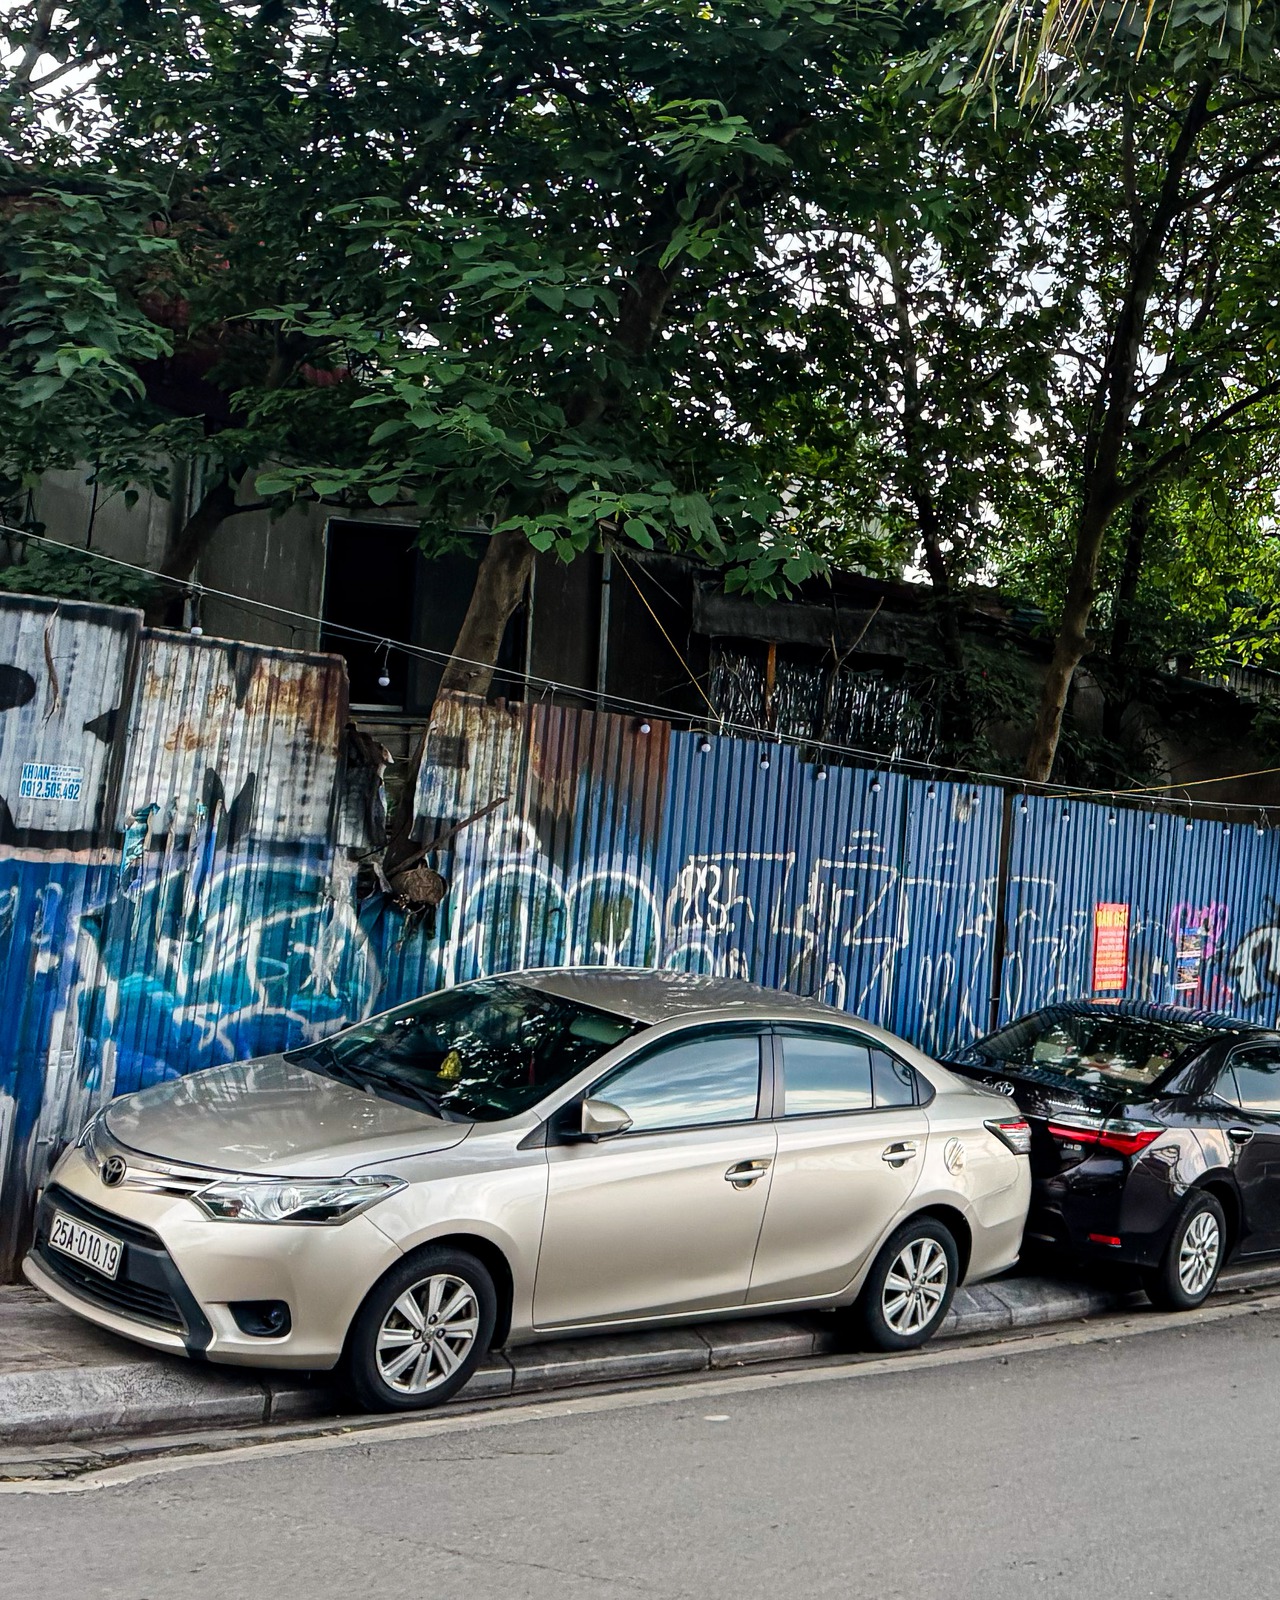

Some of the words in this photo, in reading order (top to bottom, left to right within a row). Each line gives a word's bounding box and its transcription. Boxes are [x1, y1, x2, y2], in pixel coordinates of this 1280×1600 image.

[22, 764, 51, 780] KHOAN
[20, 780, 80, 800] 0912.505.492
[51, 1218, 118, 1271] 25A-010.19
